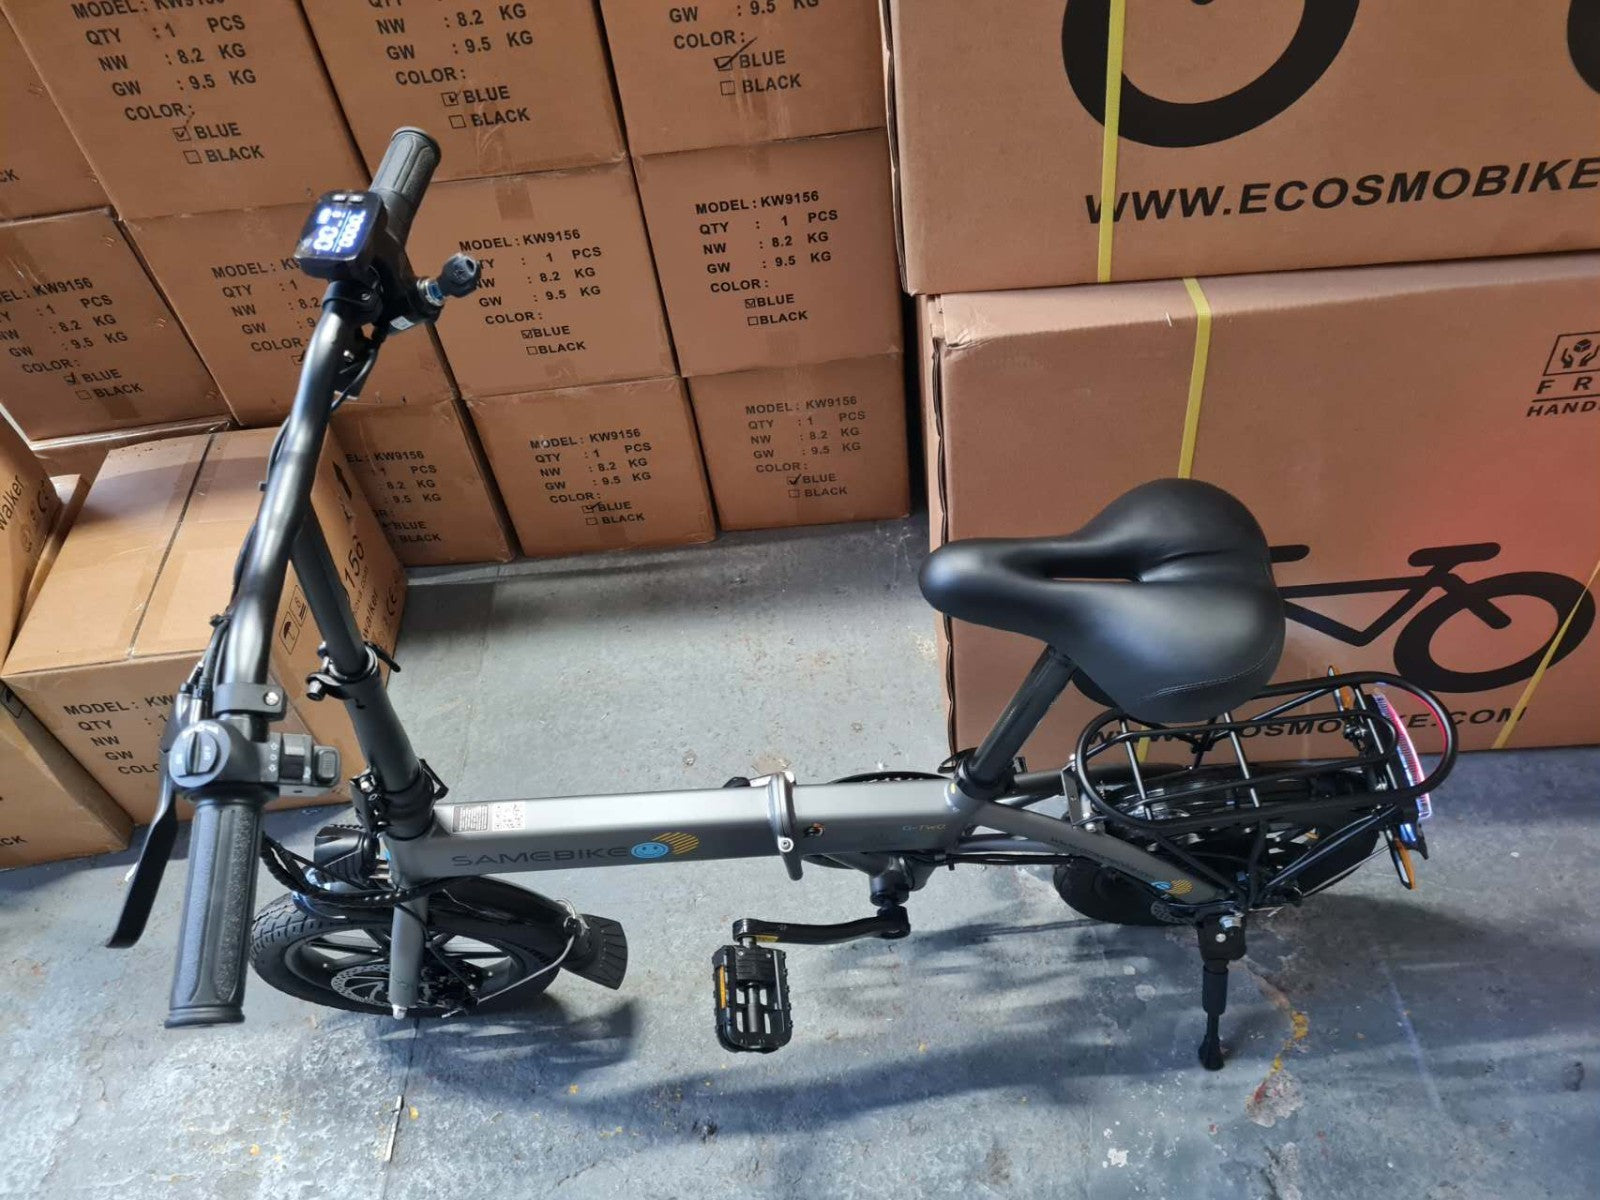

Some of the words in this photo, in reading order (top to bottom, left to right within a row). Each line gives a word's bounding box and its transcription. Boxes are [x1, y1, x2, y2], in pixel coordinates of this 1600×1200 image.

[376, 18, 405, 34] NW
[499, 3, 526, 20] KG
[669, 6, 698, 23] GW
[86, 28, 120, 45] QTY
[207, 15, 245, 33] PCS
[386, 45, 415, 60] GW
[506, 30, 533, 47] KG
[98, 55, 128, 71] NW
[218, 43, 246, 59] KG
[739, 50, 786, 68] BLUE
[112, 80, 141, 96] GW
[229, 69, 256, 85] KG
[742, 74, 801, 95] BLACK
[463, 86, 510, 103] BLUE
[470, 108, 530, 127] BLACK
[194, 123, 241, 139] BLUE
[205, 145, 264, 162] BLACK
[761, 191, 819, 207] KW9156
[699, 222, 728, 235] QTY
[808, 210, 838, 223] PCS
[523, 229, 580, 245] KW9156
[703, 243, 726, 254] NW
[807, 231, 828, 243] KG
[480, 258, 495, 270] TY
[572, 247, 601, 259] PCS
[707, 262, 730, 274] GW
[810, 251, 831, 262] KG
[574, 267, 595, 278] KG
[222, 284, 251, 298] QTY
[479, 296, 502, 307] GW
[580, 286, 600, 296] KG
[80, 295, 112, 308] PCS
[755, 294, 794, 307] BLUE
[231, 304, 256, 316] NW
[759, 311, 807, 325] BLACK
[93, 314, 116, 326] KG
[242, 323, 266, 335] GW
[533, 325, 571, 338] BLUE
[9, 346, 33, 357] GW
[104, 332, 128, 343] KG
[538, 341, 586, 354] BLACK
[81, 369, 122, 383] BLUE
[92, 383, 143, 398] BLACK
[748, 420, 773, 429] QTY
[839, 411, 865, 422] PCS
[751, 435, 771, 444] NW
[840, 427, 862, 437] KG
[535, 453, 560, 463] QTY
[625, 442, 652, 453] PCS
[753, 450, 774, 459] GW
[841, 442, 861, 452] KG
[410, 465, 437, 474] PCS
[540, 467, 560, 477] NW
[628, 458, 647, 468] KG
[416, 480, 435, 488] KG
[545, 481, 566, 490] GW
[632, 472, 651, 481] KG
[802, 473, 837, 485] BLUE
[422, 493, 441, 502] KG
[804, 486, 847, 498] BLACK
[598, 501, 632, 512] BLUE
[602, 513, 645, 524] BLACK
[78, 720, 111, 731] QTY
[91, 736, 120, 746] NW
[105, 751, 133, 760] GW
[451, 847, 629, 867] SAMEBIKE
